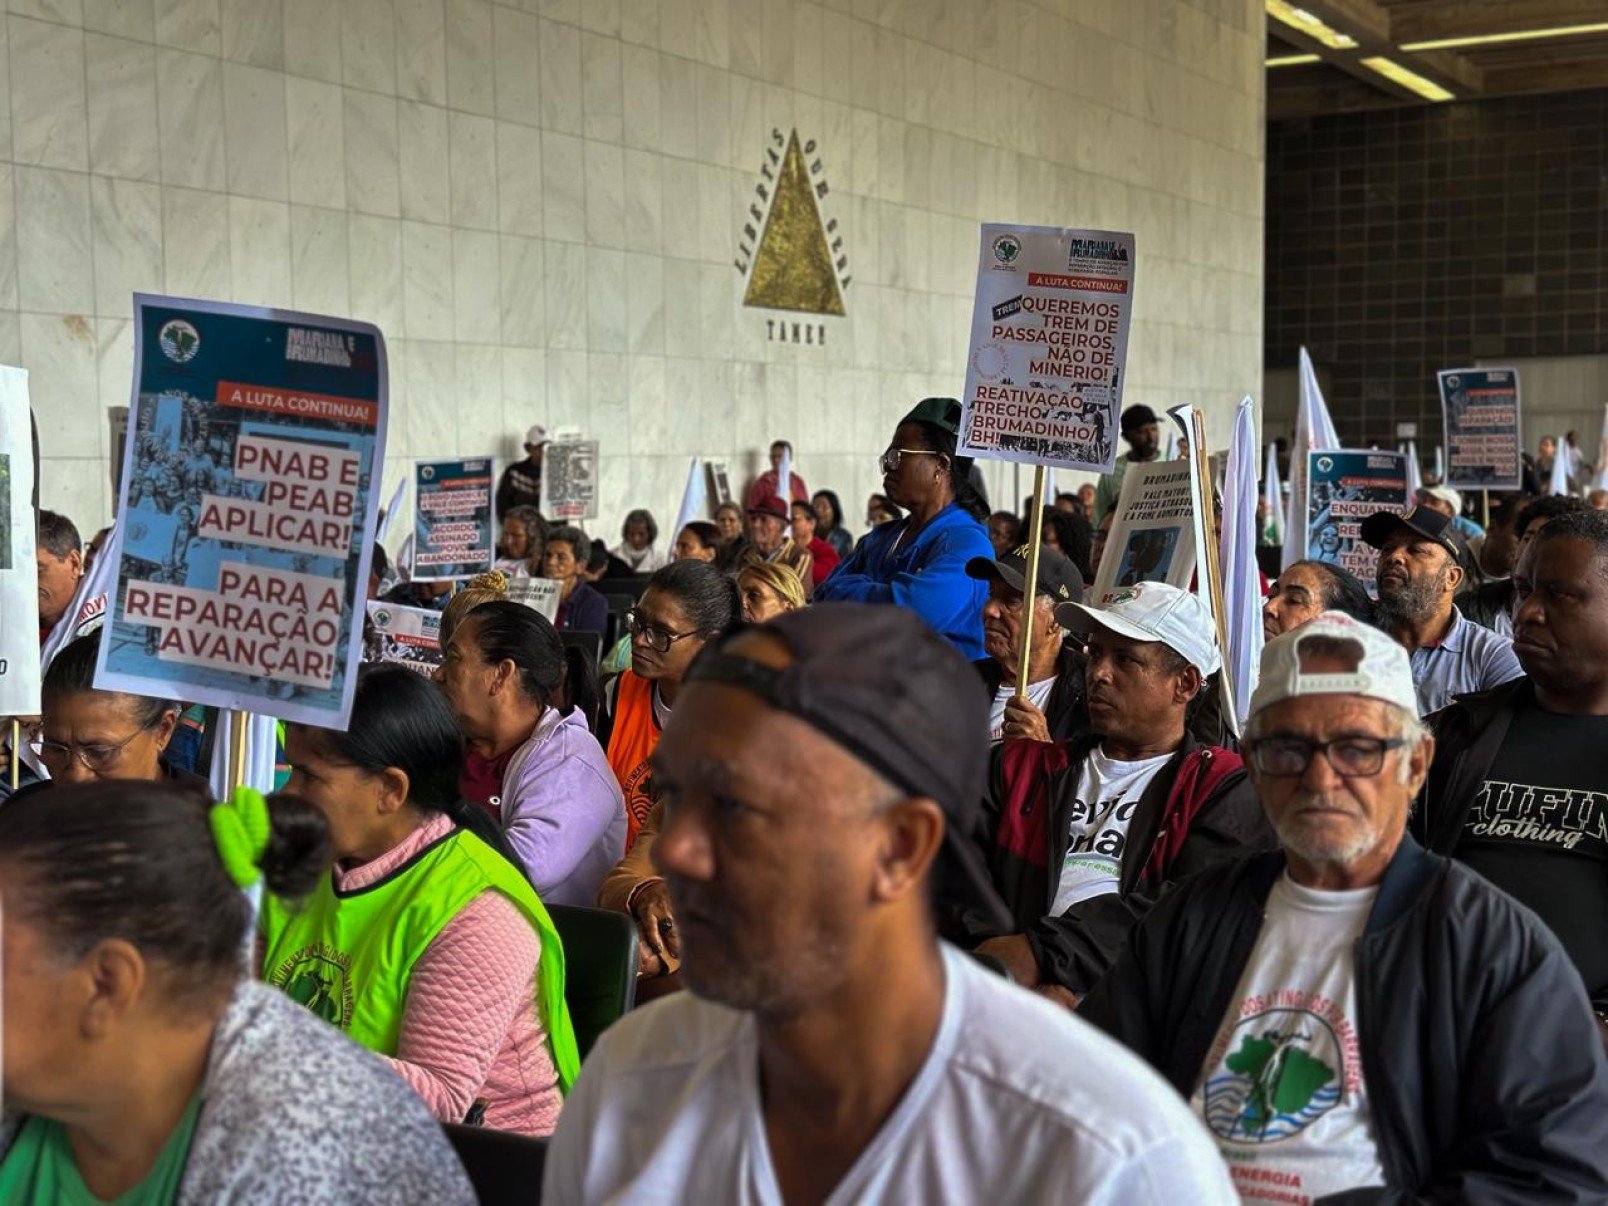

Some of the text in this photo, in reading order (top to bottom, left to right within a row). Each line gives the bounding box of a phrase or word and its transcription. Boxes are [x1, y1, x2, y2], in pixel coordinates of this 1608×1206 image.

[734, 127, 784, 276] LIBERTAS
[1045, 278, 1069, 287] LUTA
[1071, 279, 1123, 291] CONTINUA!
[1022, 297, 1119, 318] QUEREMOS
[766, 319, 825, 346] TAMEN
[1044, 315, 1118, 334] TREM DE
[992, 325, 1115, 351] PASSAGEIROS,
[1048, 343, 1114, 366] NÃO DE
[1029, 358, 1108, 381] MINÉRIO!
[231, 390, 369, 419] A LUTA CONTINUA!
[974, 401, 1041, 419] TRECHO
[977, 386, 1083, 410] REATIVAÇÃO
[971, 430, 1000, 444] BH!
[238, 444, 360, 485] PNAB E
[266, 482, 355, 516] PEAB
[1144, 489, 1162, 500] VALE
[200, 504, 350, 549] APLICAR!
[429, 533, 477, 544] ASSINADO
[434, 523, 475, 533] ACORDO
[1341, 554, 1369, 565] TEM
[220, 571, 341, 615] PARA A
[126, 589, 337, 648] REPARAÇÃO
[160, 626, 334, 680] AVANÇAR!
[1472, 814, 1585, 849] clothing
